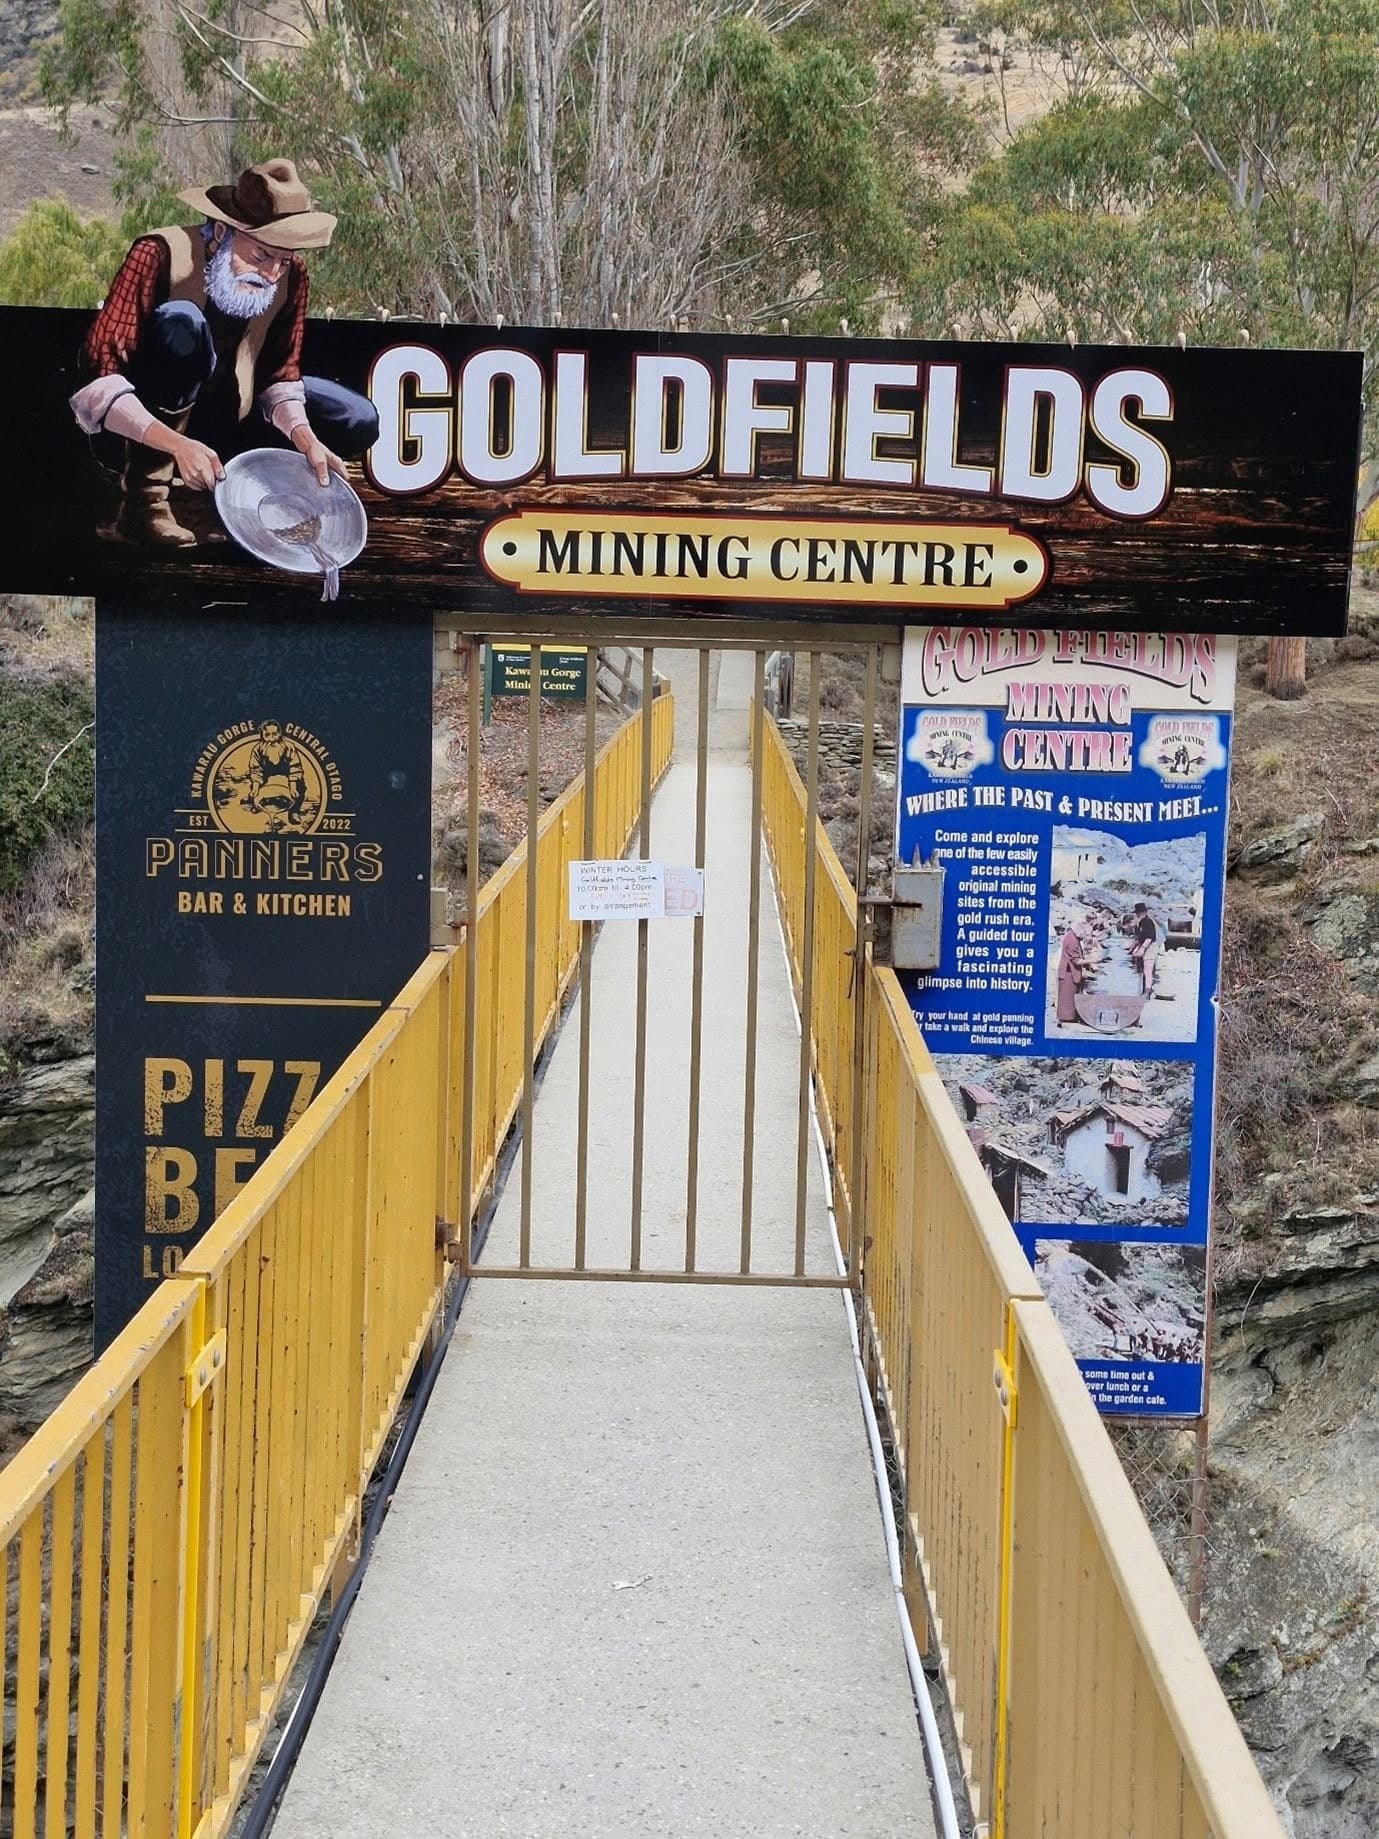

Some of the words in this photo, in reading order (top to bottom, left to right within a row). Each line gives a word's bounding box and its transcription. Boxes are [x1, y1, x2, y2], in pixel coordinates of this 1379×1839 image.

[367, 344, 1175, 518] GOLDFIELDS
[535, 529, 750, 581] MINING
[769, 537, 994, 588] CENTRE
[551, 667, 582, 679] Gorge
[922, 627, 1047, 697] GOLD
[1053, 630, 1216, 704] FIELDS
[543, 681, 576, 691] Centre
[1006, 682, 1132, 725] MINING
[1003, 729, 1133, 773] CENTRE
[191, 743, 218, 797] KAWARAU
[216, 720, 255, 744] GORGE
[285, 722, 329, 761] CENTRAL
[325, 762, 343, 800] OTAGO
[905, 786, 968, 816] WHERE
[972, 785, 1006, 807] THE
[1011, 787, 1054, 811] PAST
[1058, 795, 1073, 816] &
[1078, 796, 1153, 823] PRESENT
[1158, 796, 1219, 822] MEET...
[189, 815, 208, 827] EST
[322, 818, 351, 830] 2022
[935, 829, 968, 842] Come
[971, 831, 992, 843] and
[996, 832, 1039, 846] explore
[146, 837, 384, 882] PANNERS
[955, 847, 966, 858] of
[968, 847, 984, 859] the
[986, 847, 1005, 859] few
[1007, 848, 1038, 863] easily
[580, 866, 613, 874] WINTER
[617, 865, 647, 873] HOURS
[971, 864, 1037, 877] accessible
[958, 880, 998, 893] original
[1001, 881, 1036, 895] mining
[178, 891, 223, 914] BAR
[233, 892, 247, 914] &
[256, 893, 351, 916] KITCHEN
[957, 896, 985, 908] sites
[988, 896, 1018, 909] from
[1018, 897, 1037, 910] the
[957, 912, 981, 926] gold
[984, 912, 1009, 925] rush
[1013, 915, 1034, 926] era.
[957, 928, 966, 940] A
[969, 929, 1008, 943] guided
[1011, 930, 1035, 942] tour
[956, 944, 990, 958] gives
[996, 947, 1019, 960] you
[1026, 948, 1034, 958] a
[957, 960, 1033, 977] fascinating
[917, 975, 962, 991] glimpse
[965, 976, 987, 990] into
[990, 976, 1033, 993] history.
[928, 1012, 946, 1021] your
[948, 1010, 968, 1020] hand
[972, 1012, 981, 1021] at
[982, 1012, 1000, 1023] gold
[1002, 1013, 1034, 1024] panning
[924, 1022, 942, 1031] take
[944, 1024, 950, 1032] a
[951, 1022, 970, 1033] walk
[972, 1023, 987, 1033] and
[989, 1024, 1019, 1035] explore
[1021, 1025, 1034, 1034] the
[970, 1034, 1003, 1045] Chinese
[1004, 1035, 1034, 1047] village.
[145, 1146, 257, 1234] BE
[1085, 1370, 1108, 1379] some
[1110, 1370, 1129, 1380] time
[1131, 1371, 1145, 1380] out
[1147, 1371, 1154, 1380] &
[1086, 1382, 1105, 1390] over
[1106, 1381, 1129, 1391] lunch
[1131, 1383, 1141, 1392] or
[1143, 1384, 1149, 1392] a
[1098, 1393, 1113, 1402] the
[1114, 1394, 1144, 1405] garden
